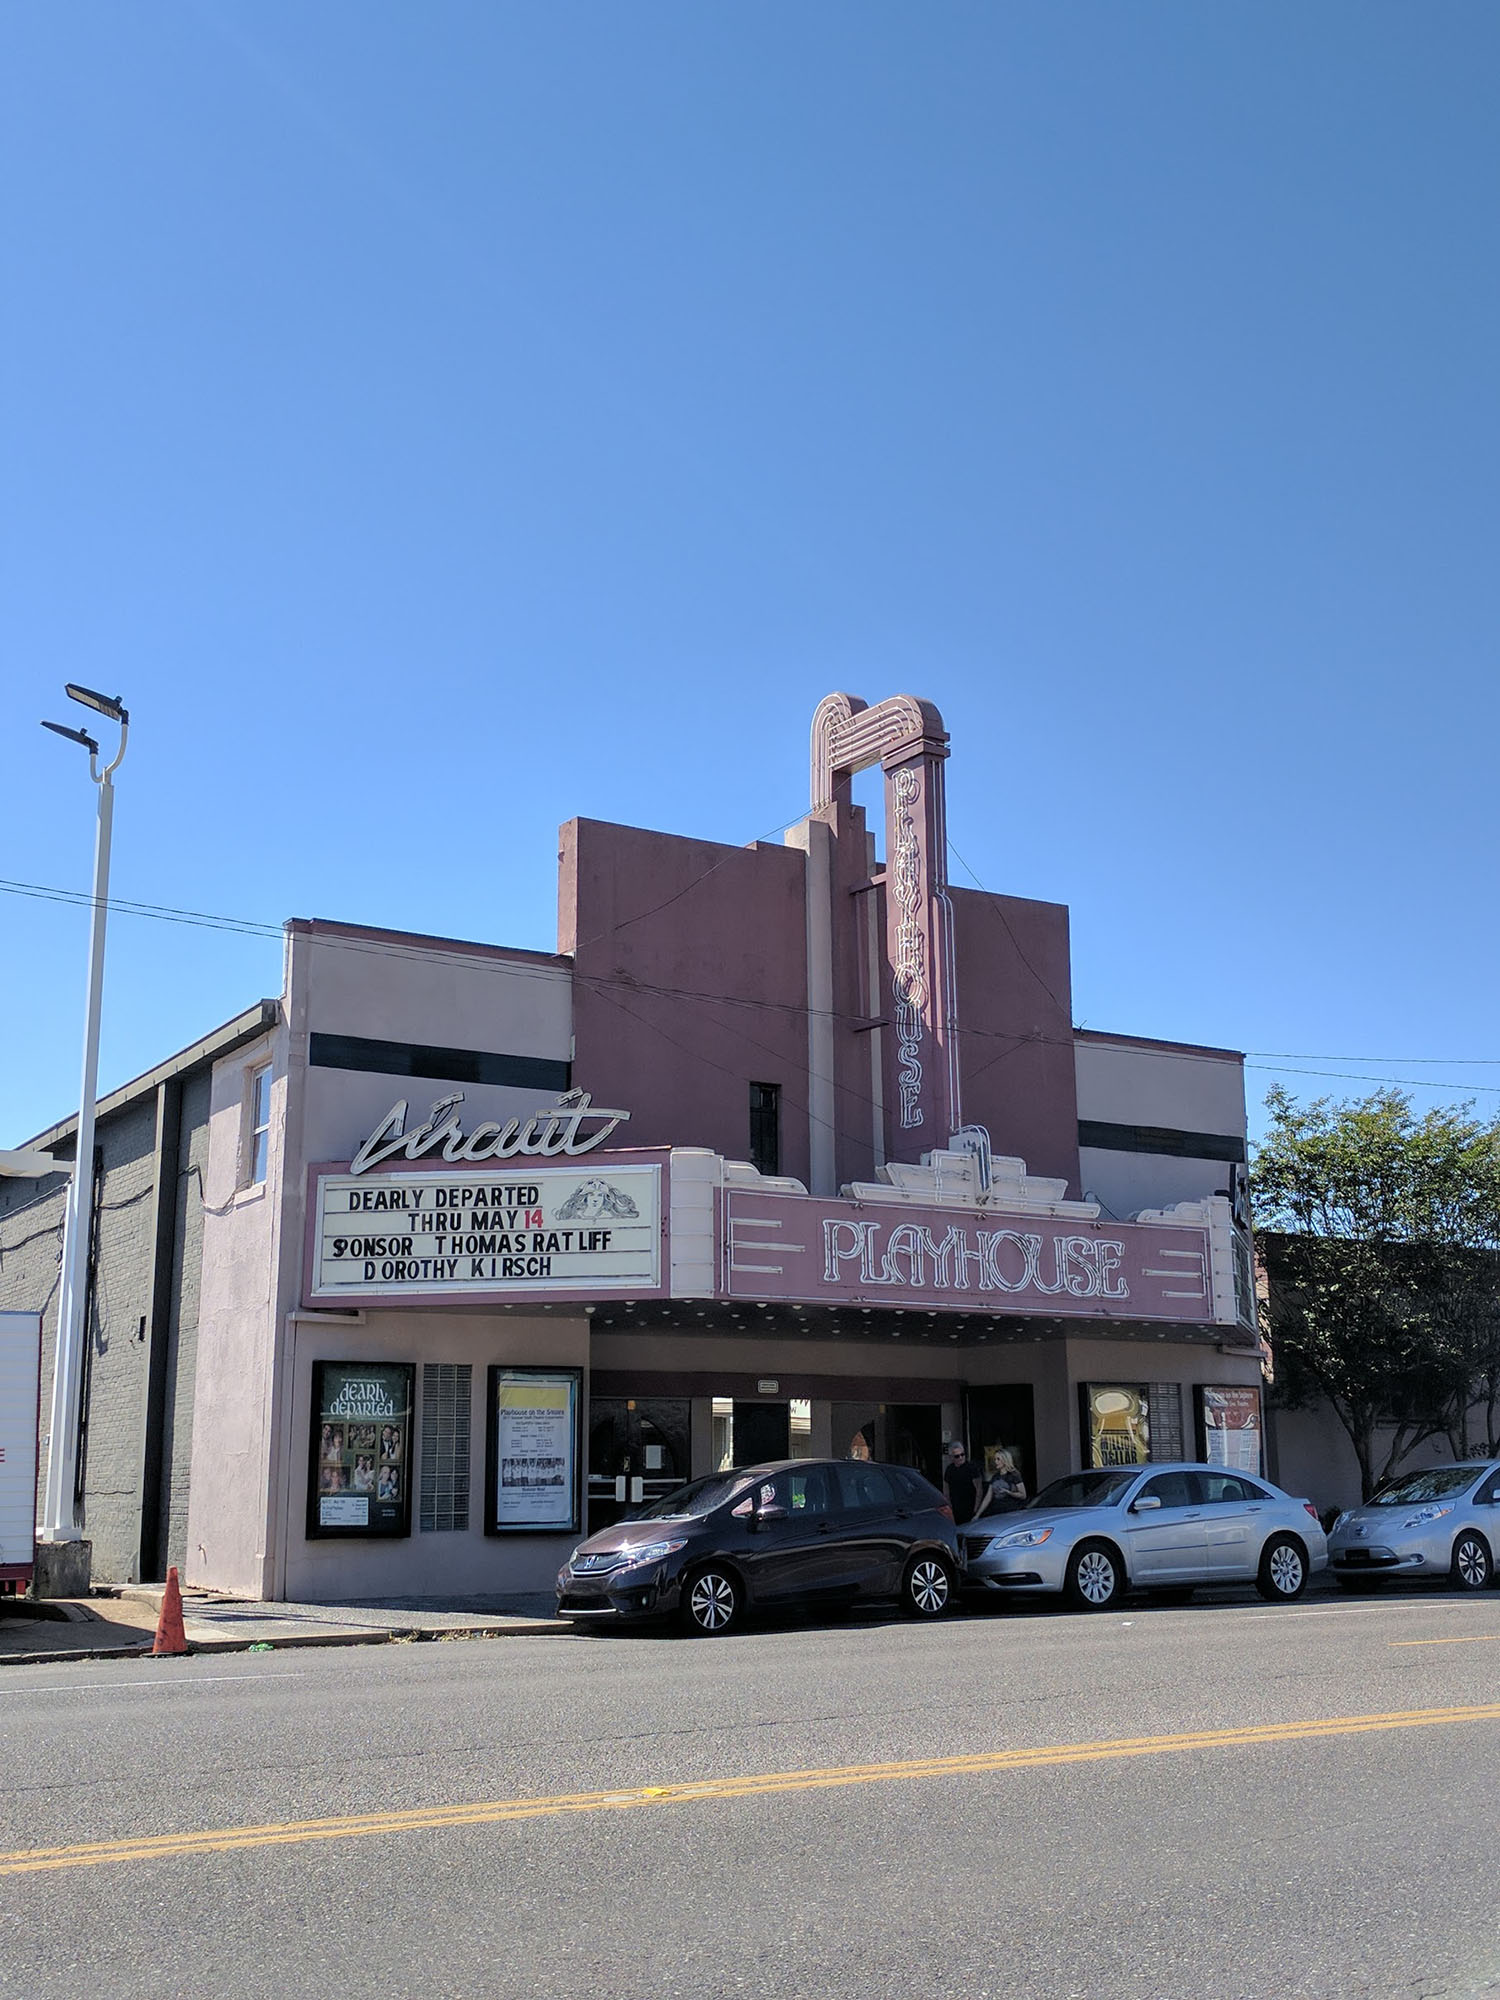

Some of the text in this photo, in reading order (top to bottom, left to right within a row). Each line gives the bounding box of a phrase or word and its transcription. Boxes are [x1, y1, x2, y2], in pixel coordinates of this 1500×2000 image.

[891, 767, 924, 1128] PLAYHOUSE
[350, 1086, 632, 1176] Circuit
[350, 1185, 540, 1211] DEARLY DEPARTED
[408, 1208, 544, 1233] THRU MAY 14
[435, 1233, 527, 1255] THOMAS
[533, 1230, 612, 1254] RATLIFF
[364, 1256, 551, 1281] DOROTHY KIRSCH
[822, 1218, 1130, 1298] PLAYHOUSE
